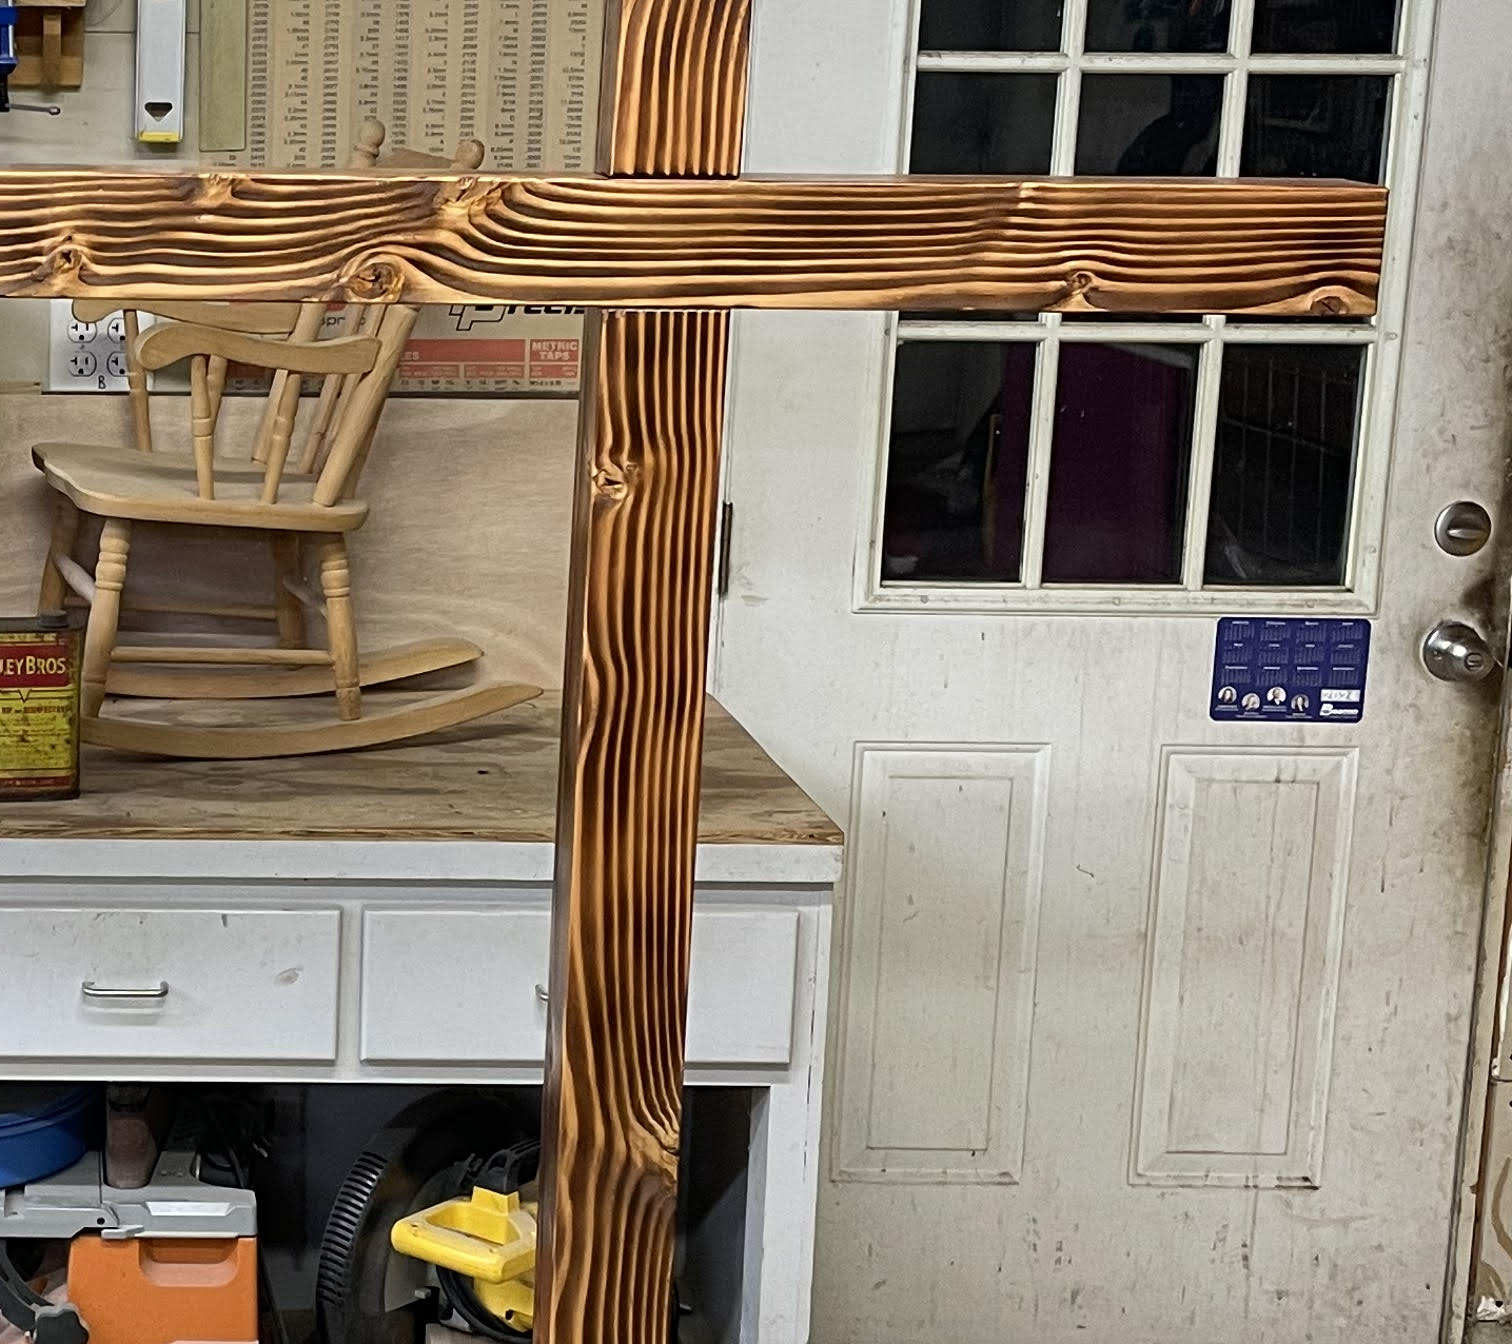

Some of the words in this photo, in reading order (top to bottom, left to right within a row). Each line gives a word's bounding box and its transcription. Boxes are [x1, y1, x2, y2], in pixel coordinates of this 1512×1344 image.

[532, 341, 578, 351] METRIC
[538, 351, 570, 361] TAPS
[98, 375, 107, 390] B
[26, 656, 67, 675] BROS
